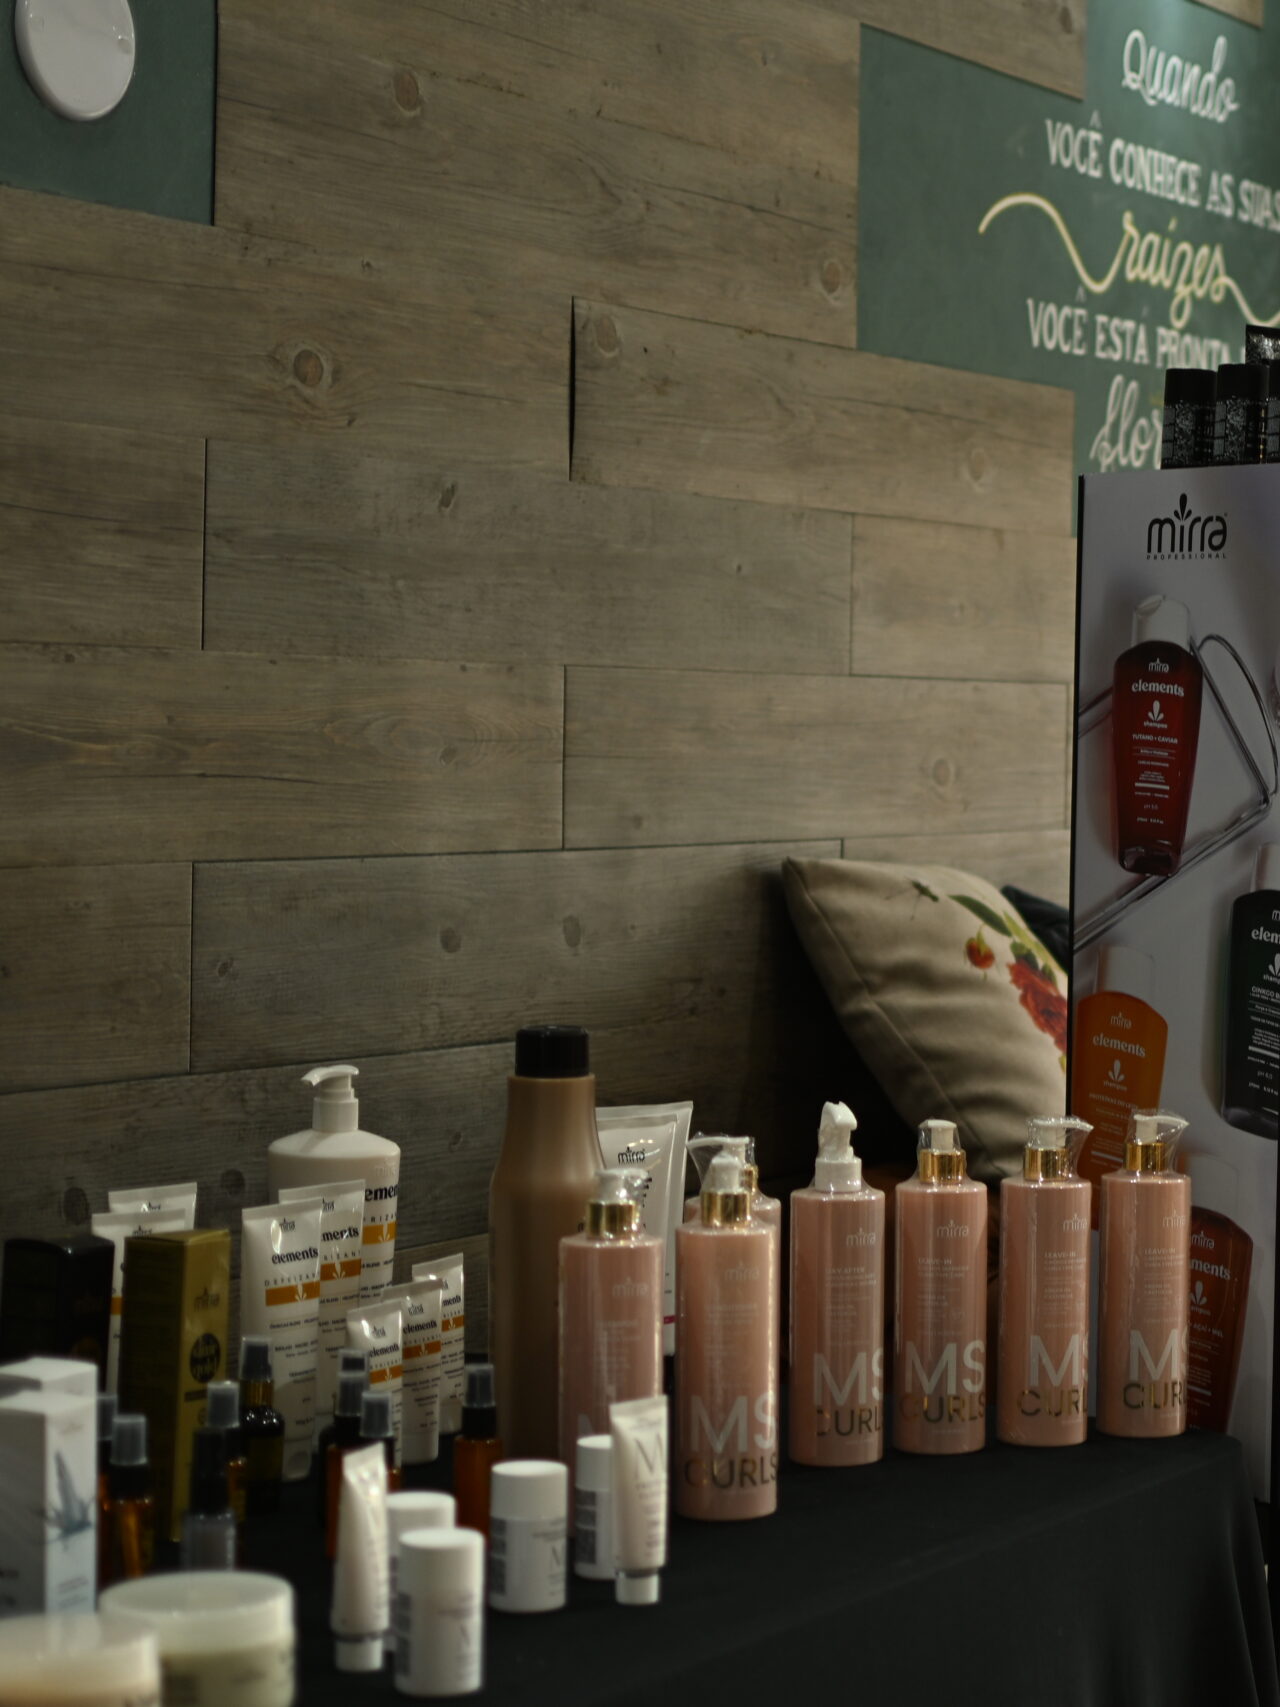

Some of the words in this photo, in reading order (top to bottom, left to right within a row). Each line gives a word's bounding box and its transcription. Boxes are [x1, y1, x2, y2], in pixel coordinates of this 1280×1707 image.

[1121, 28, 1240, 123] Quando
[1044, 110, 1103, 179] VOCÊ
[1109, 137, 1202, 208] CONHECE
[1205, 169, 1235, 218] AS
[1026, 284, 1088, 356] VOCÊ
[1094, 305, 1150, 366] ESTÁ
[1089, 373, 1163, 473] flor
[1147, 493, 1227, 552] mirra
[1131, 679, 1185, 698] elements
[1092, 1032, 1147, 1059] elements
[321, 1225, 360, 1243] ments
[936, 1219, 970, 1239] mirra
[271, 1247, 319, 1266] elements
[1190, 1258, 1231, 1281] ments
[402, 1320, 438, 1335] elements
[904, 1339, 986, 1396] MS
[901, 1393, 985, 1424] CURLS
[1017, 1389, 1088, 1417] CURL
[1122, 1382, 1187, 1410] CUR
[690, 1391, 778, 1454] MS
[816, 1405, 884, 1437] CURL
[684, 1453, 779, 1490] CURLS
